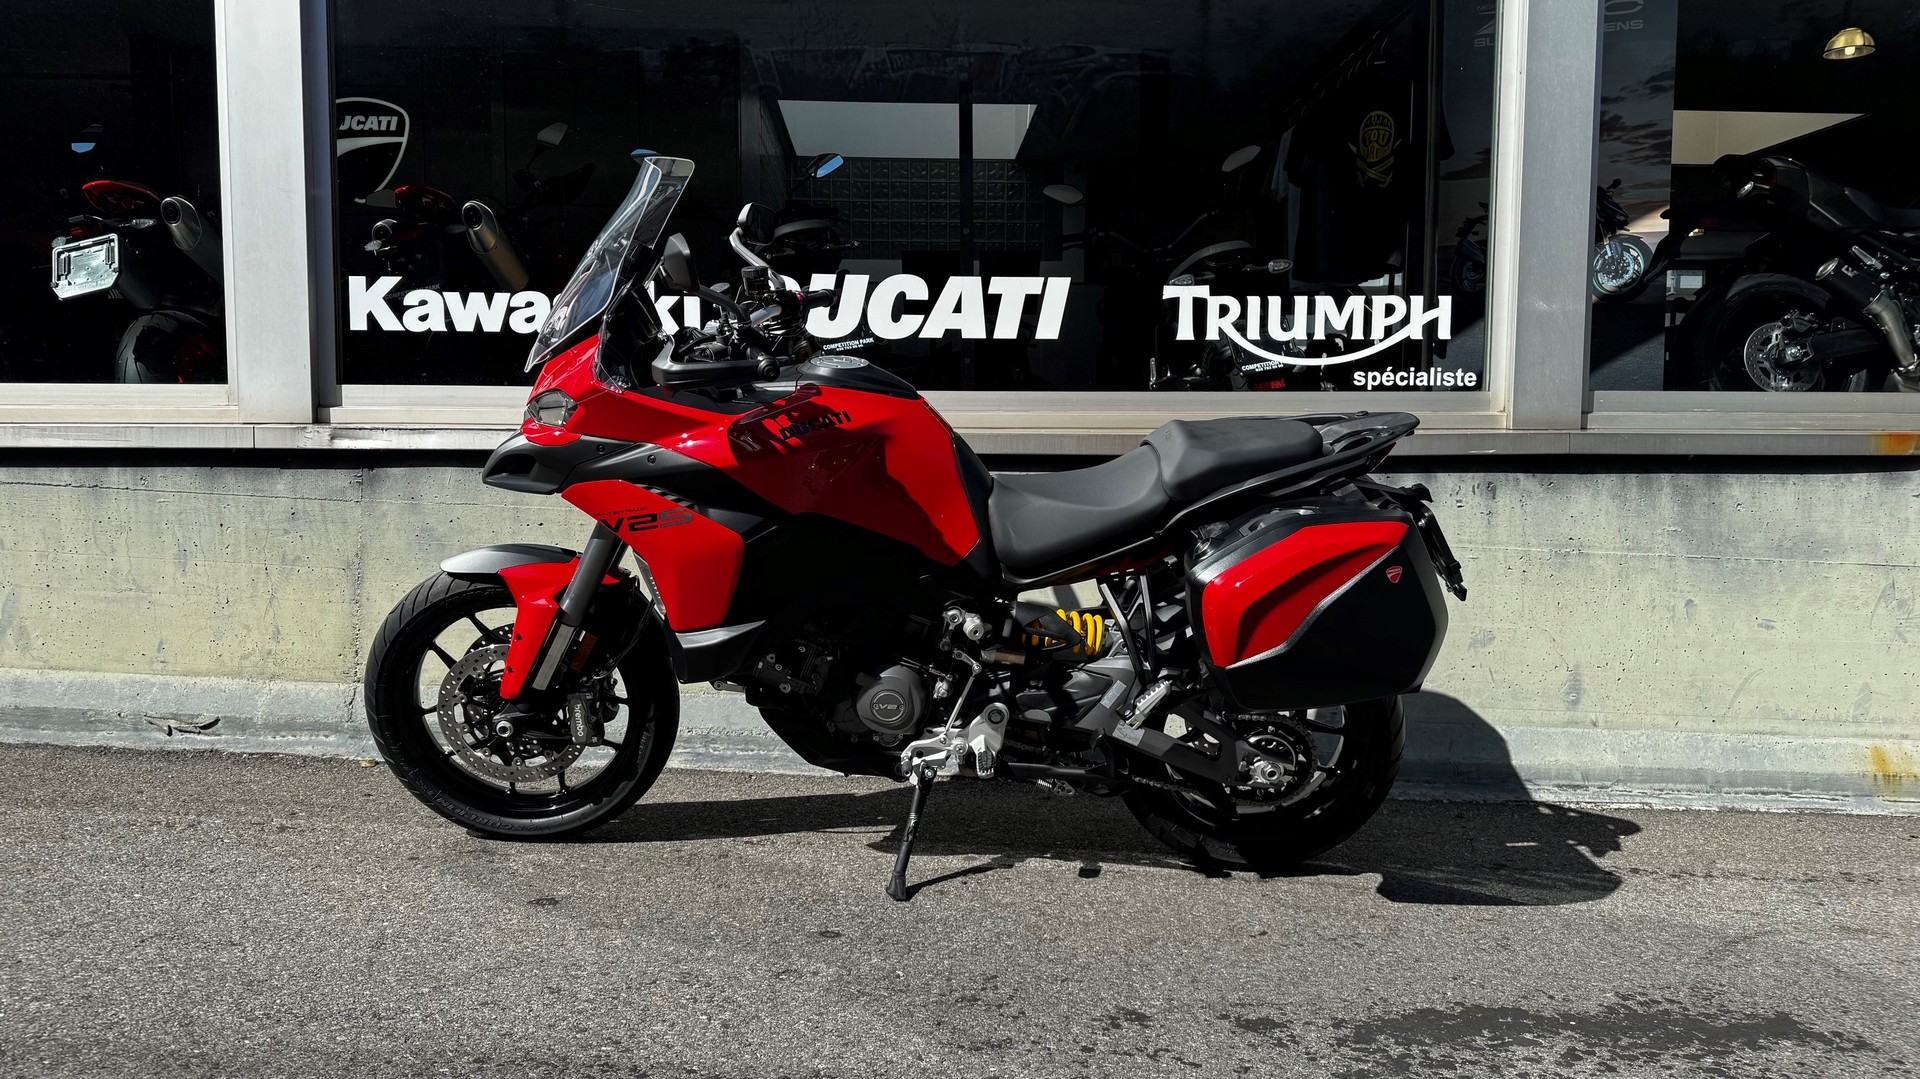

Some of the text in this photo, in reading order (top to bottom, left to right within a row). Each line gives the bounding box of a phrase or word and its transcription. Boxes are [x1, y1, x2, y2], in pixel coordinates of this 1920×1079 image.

[338, 115, 398, 131] UCATI
[348, 276, 701, 335] Kawaki
[771, 273, 1071, 340] UCATI
[1161, 285, 1453, 366] TRIUMPH
[822, 340, 860, 351] COMPETITION
[859, 337, 875, 345] PARK
[1353, 366, 1477, 390] spécialiste
[779, 410, 852, 441] DUCATI
[573, 703, 584, 737] brembo
